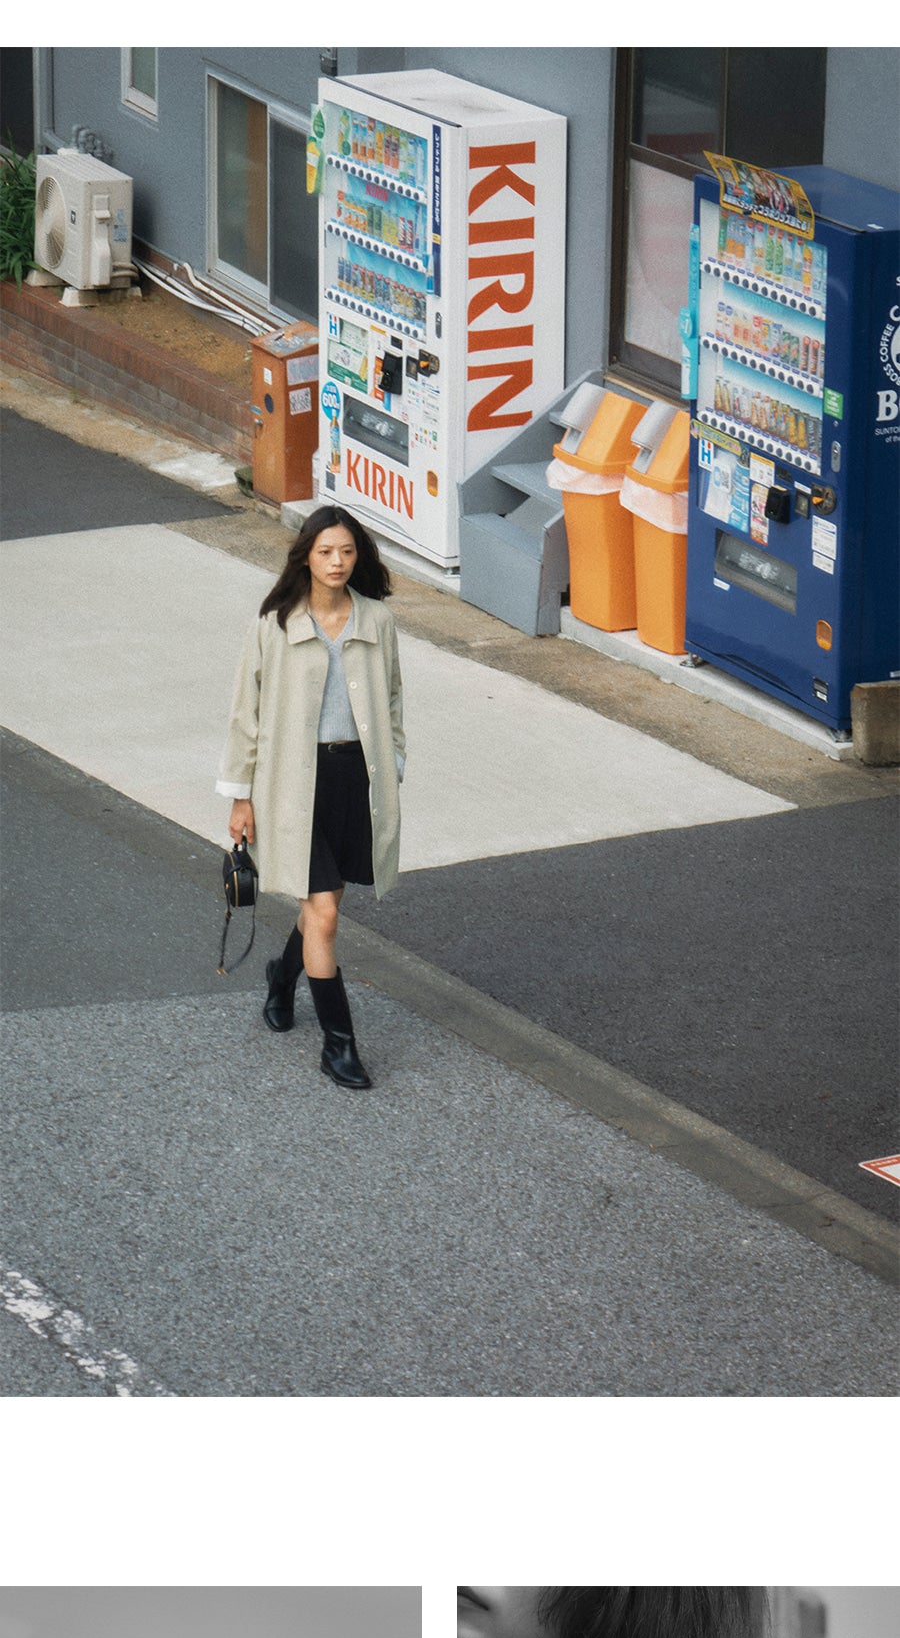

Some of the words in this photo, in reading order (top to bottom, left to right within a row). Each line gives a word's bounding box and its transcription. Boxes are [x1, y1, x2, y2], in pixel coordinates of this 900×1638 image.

[467, 141, 536, 432] KIRIN
[880, 323, 895, 363] COFFEE
[874, 426, 900, 436] SUNTO
[346, 448, 414, 520] KIRIN
